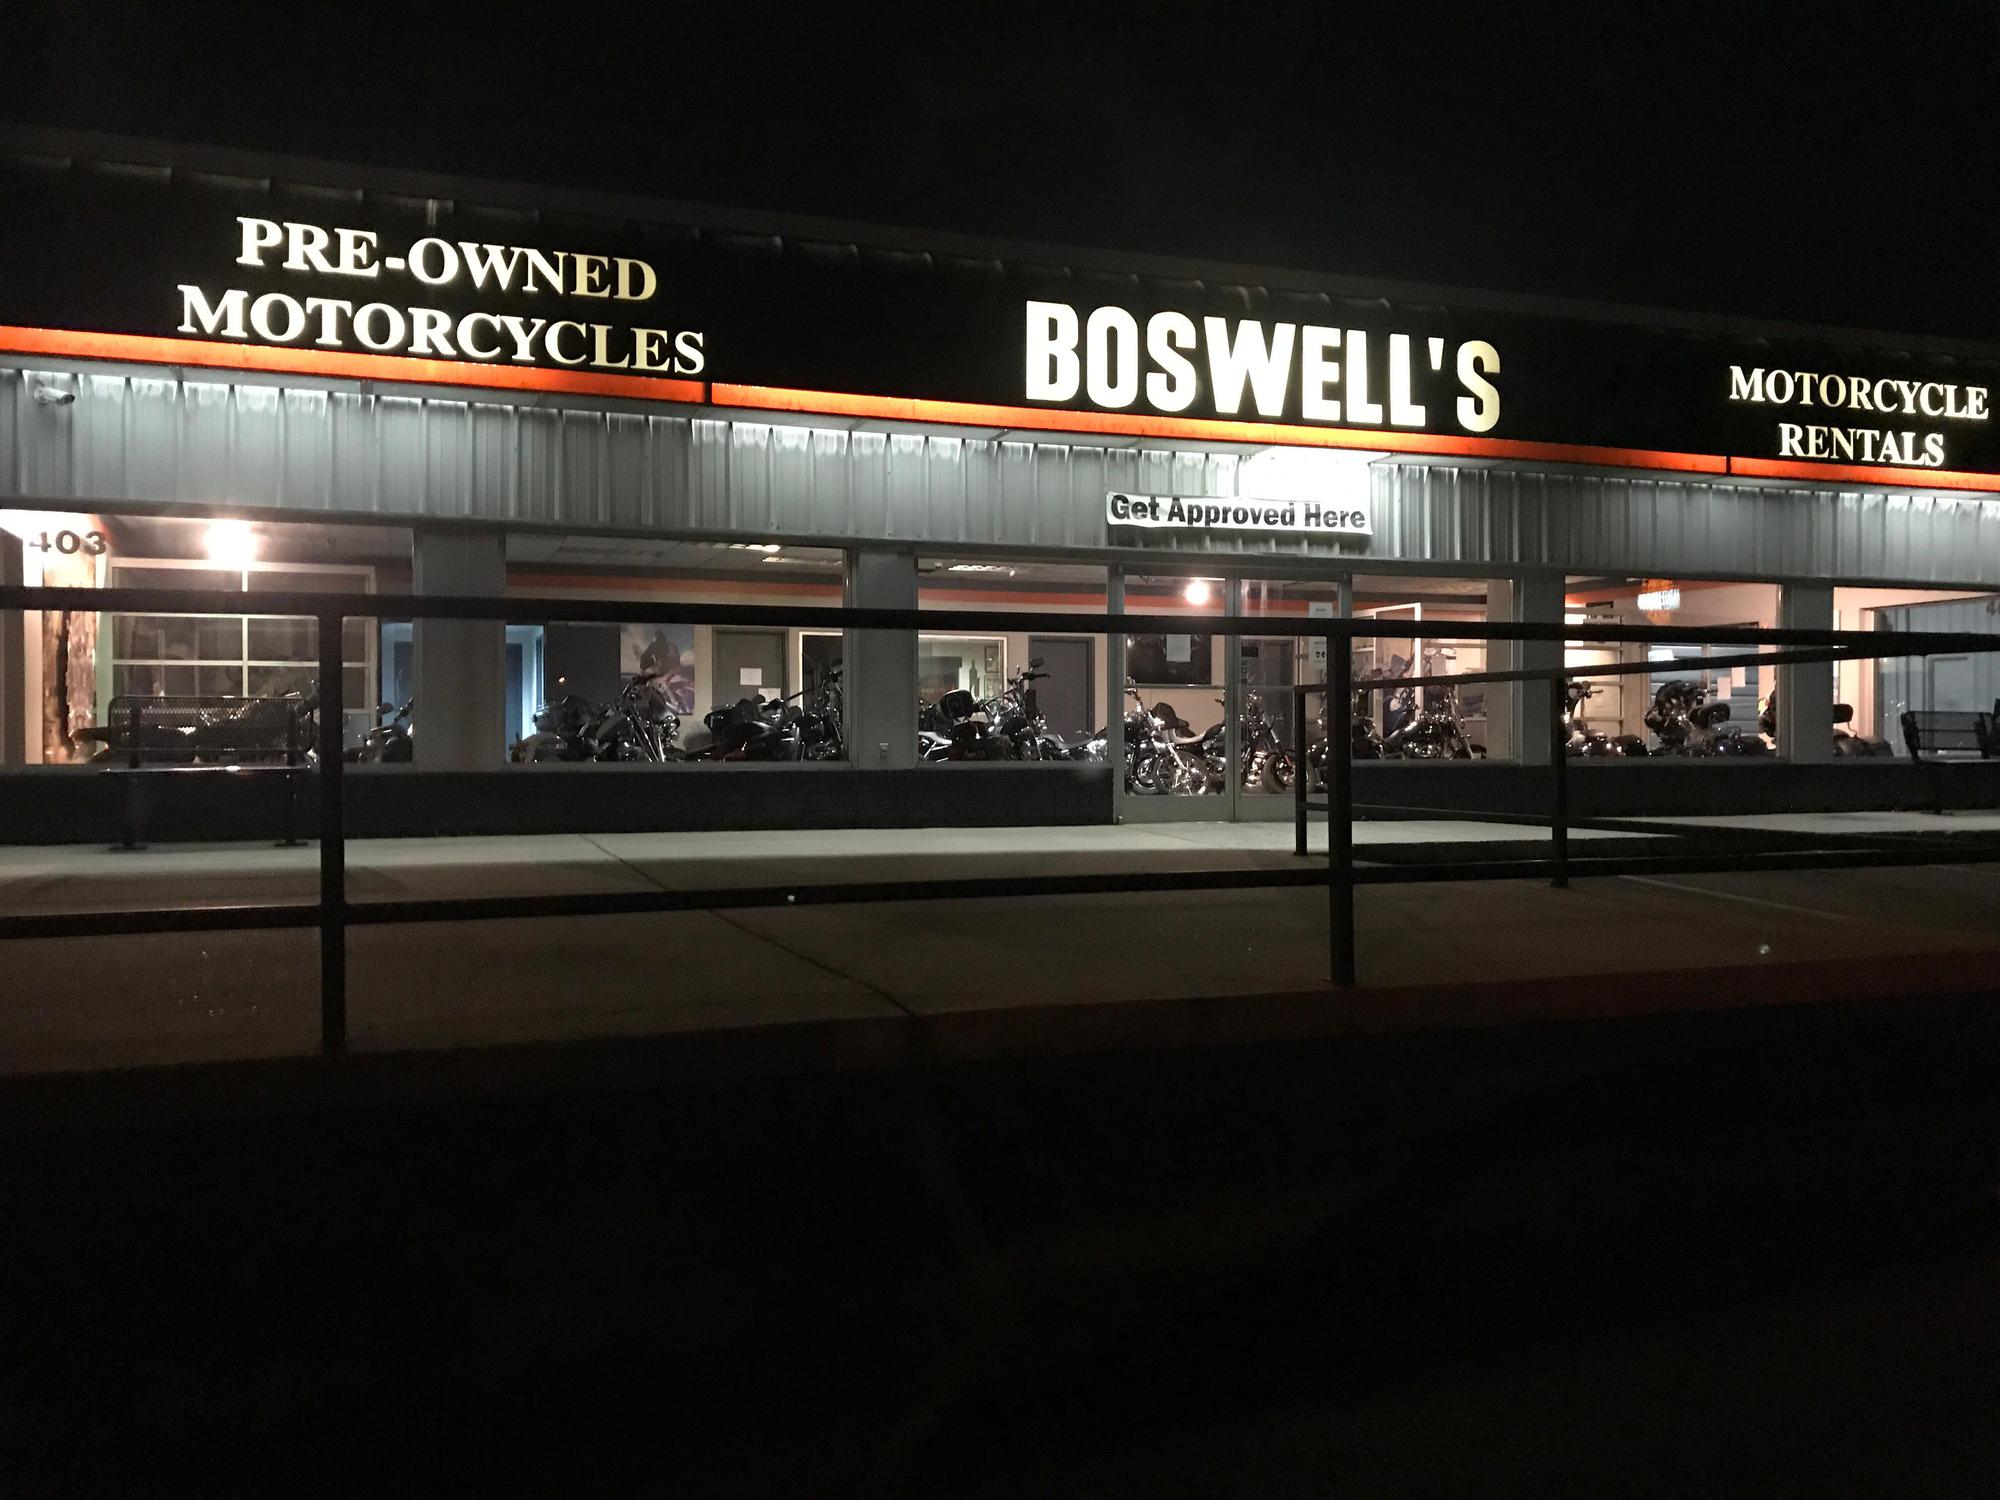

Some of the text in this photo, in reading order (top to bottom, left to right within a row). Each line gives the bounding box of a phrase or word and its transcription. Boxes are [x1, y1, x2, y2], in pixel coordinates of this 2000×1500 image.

[236, 216, 657, 301] PRE-OWNED
[176, 284, 706, 375] MOTORCYCLES
[1025, 300, 1501, 433] BOSWELL'S
[1729, 365, 1990, 420] MOTORCYCLE
[1778, 423, 1945, 467] RENTALS
[1110, 494, 1366, 528] Get Approved Here
[29, 529, 107, 556] 403
